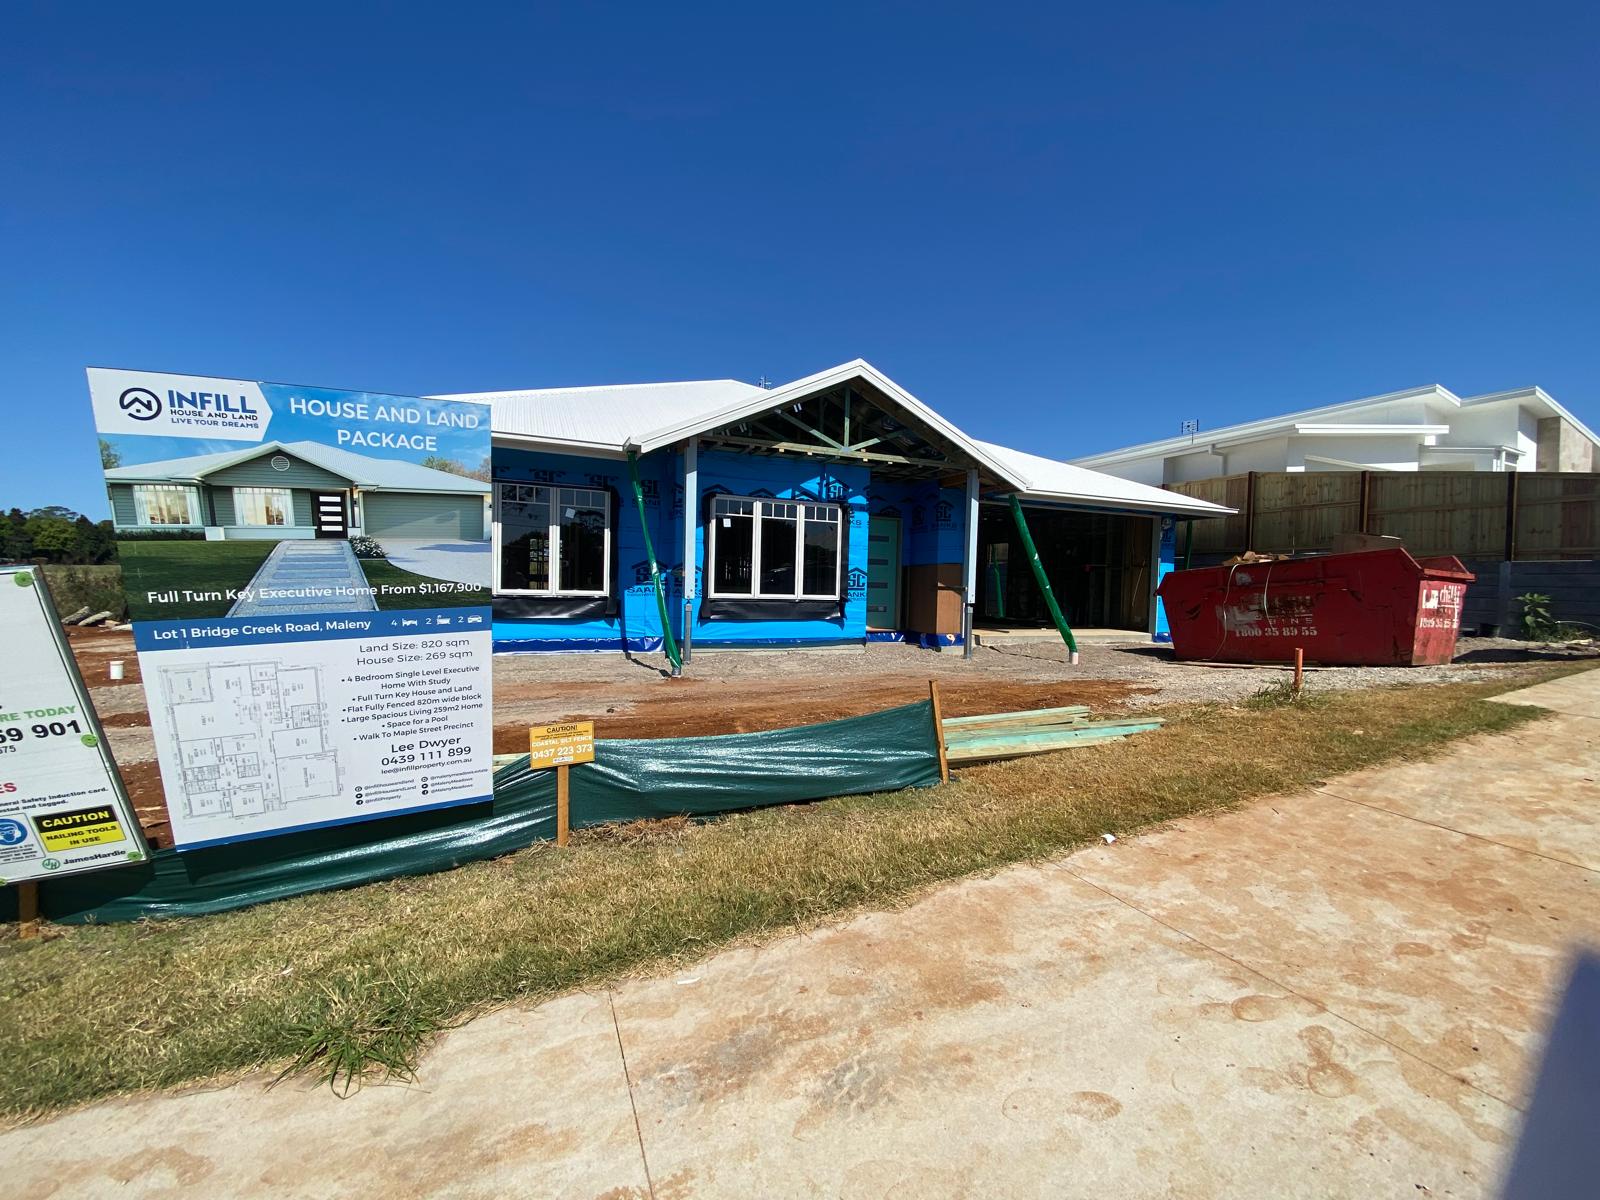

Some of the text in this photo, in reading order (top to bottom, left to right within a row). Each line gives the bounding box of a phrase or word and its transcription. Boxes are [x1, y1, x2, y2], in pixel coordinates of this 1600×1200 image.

[168, 390, 257, 414] INFILL
[170, 409, 203, 417] HOUSE
[207, 411, 227, 419] AND
[290, 398, 479, 429] HOUSE AND LAND
[222, 421, 259, 429] DREAMS
[338, 429, 438, 451] PACKAGE
[148, 582, 482, 604] Full Turn Key Executive Home From $1,167,900
[154, 619, 371, 640] Lot 1 Bridge Creek Road, Maleny
[391, 619, 398, 627] 4
[1302, 627, 1317, 636] 55
[359, 643, 389, 653] Land
[392, 642, 419, 651] Size:
[421, 640, 443, 649] 820
[357, 651, 473, 666] House Size: 269 sqm
[355, 673, 394, 682] Bedroom
[396, 671, 421, 680] Single
[444, 666, 480, 675] Executive
[381, 682, 406, 690] Home
[428, 678, 451, 686] Study
[358, 694, 373, 702] Full
[396, 691, 410, 699] Key
[412, 689, 437, 697] House
[365, 703, 385, 711] Fully
[387, 701, 415, 709] Fenced
[417, 698, 440, 706] 820m
[24, 706, 76, 719] TODAY
[347, 715, 370, 724] Large
[372, 711, 408, 721] Spacious
[410, 708, 432, 716] Living
[434, 706, 460, 714] 259m2
[31, 720, 81, 739] 901
[359, 732, 380, 741] Walk
[393, 729, 418, 738] Maple
[419, 726, 442, 734] Street
[444, 722, 474, 731] Precinct
[387, 721, 411, 729] Space
[547, 725, 578, 734] CAUTION!
[391, 737, 461, 754] Lee Dwyer
[533, 744, 593, 759] 0437 223 373
[381, 747, 472, 766] 0439 111 899
[382, 758, 472, 775] lee@infillproperty.com.au
[42, 811, 110, 828] CAUTION
[46, 826, 117, 841] NAILING TOOLS
[63, 850, 126, 865] JamesHardie
